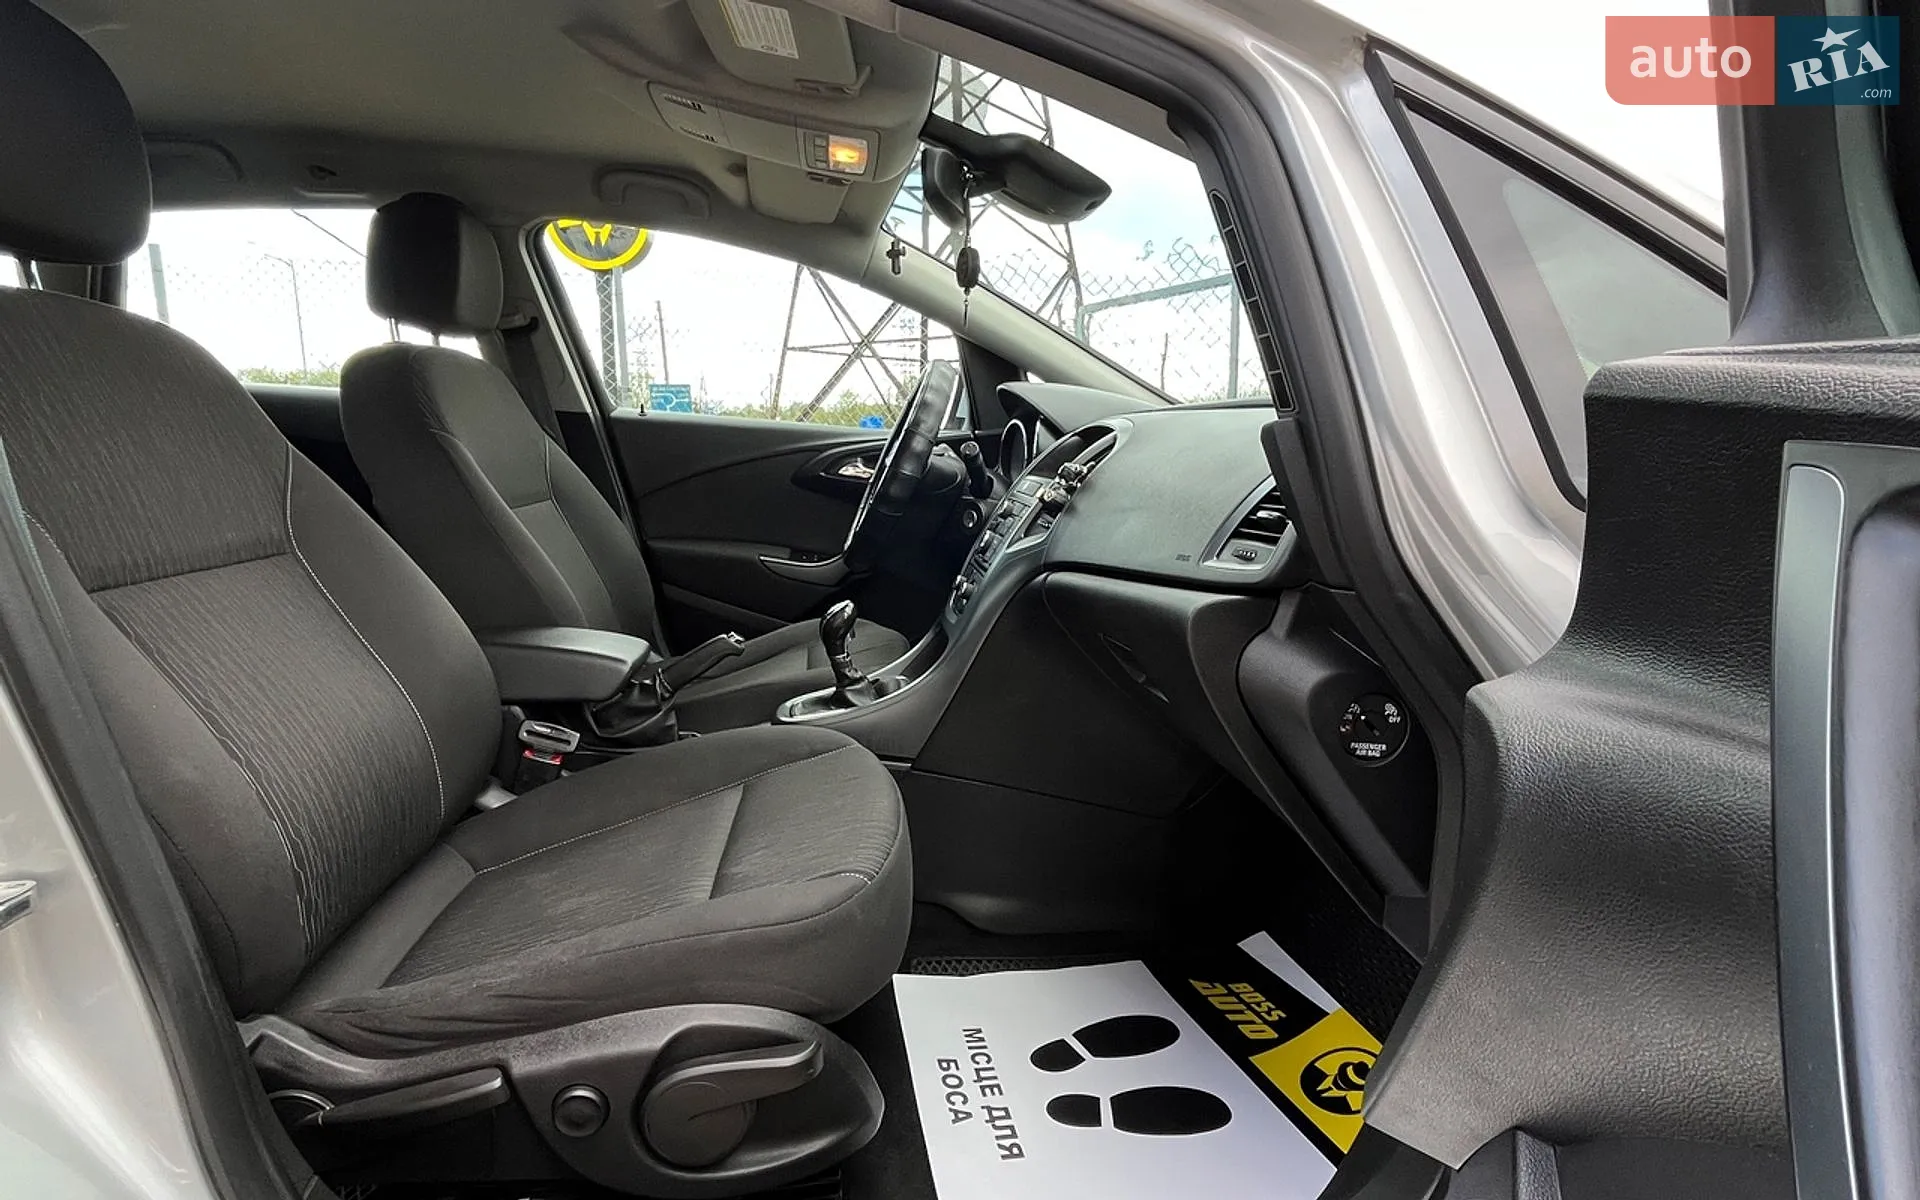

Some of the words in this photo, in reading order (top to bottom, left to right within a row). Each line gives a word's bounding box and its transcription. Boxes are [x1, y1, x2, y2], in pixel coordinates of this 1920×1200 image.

[1350, 742, 1387, 751] PASSENGER
[1188, 978, 1279, 1040] AUTO
[1227, 982, 1287, 1022] BOSS
[936, 1057, 974, 1125] БОСА
[962, 1027, 1004, 1098] МІСЦЕ
[980, 1105, 1026, 1161] ДЛЯ
